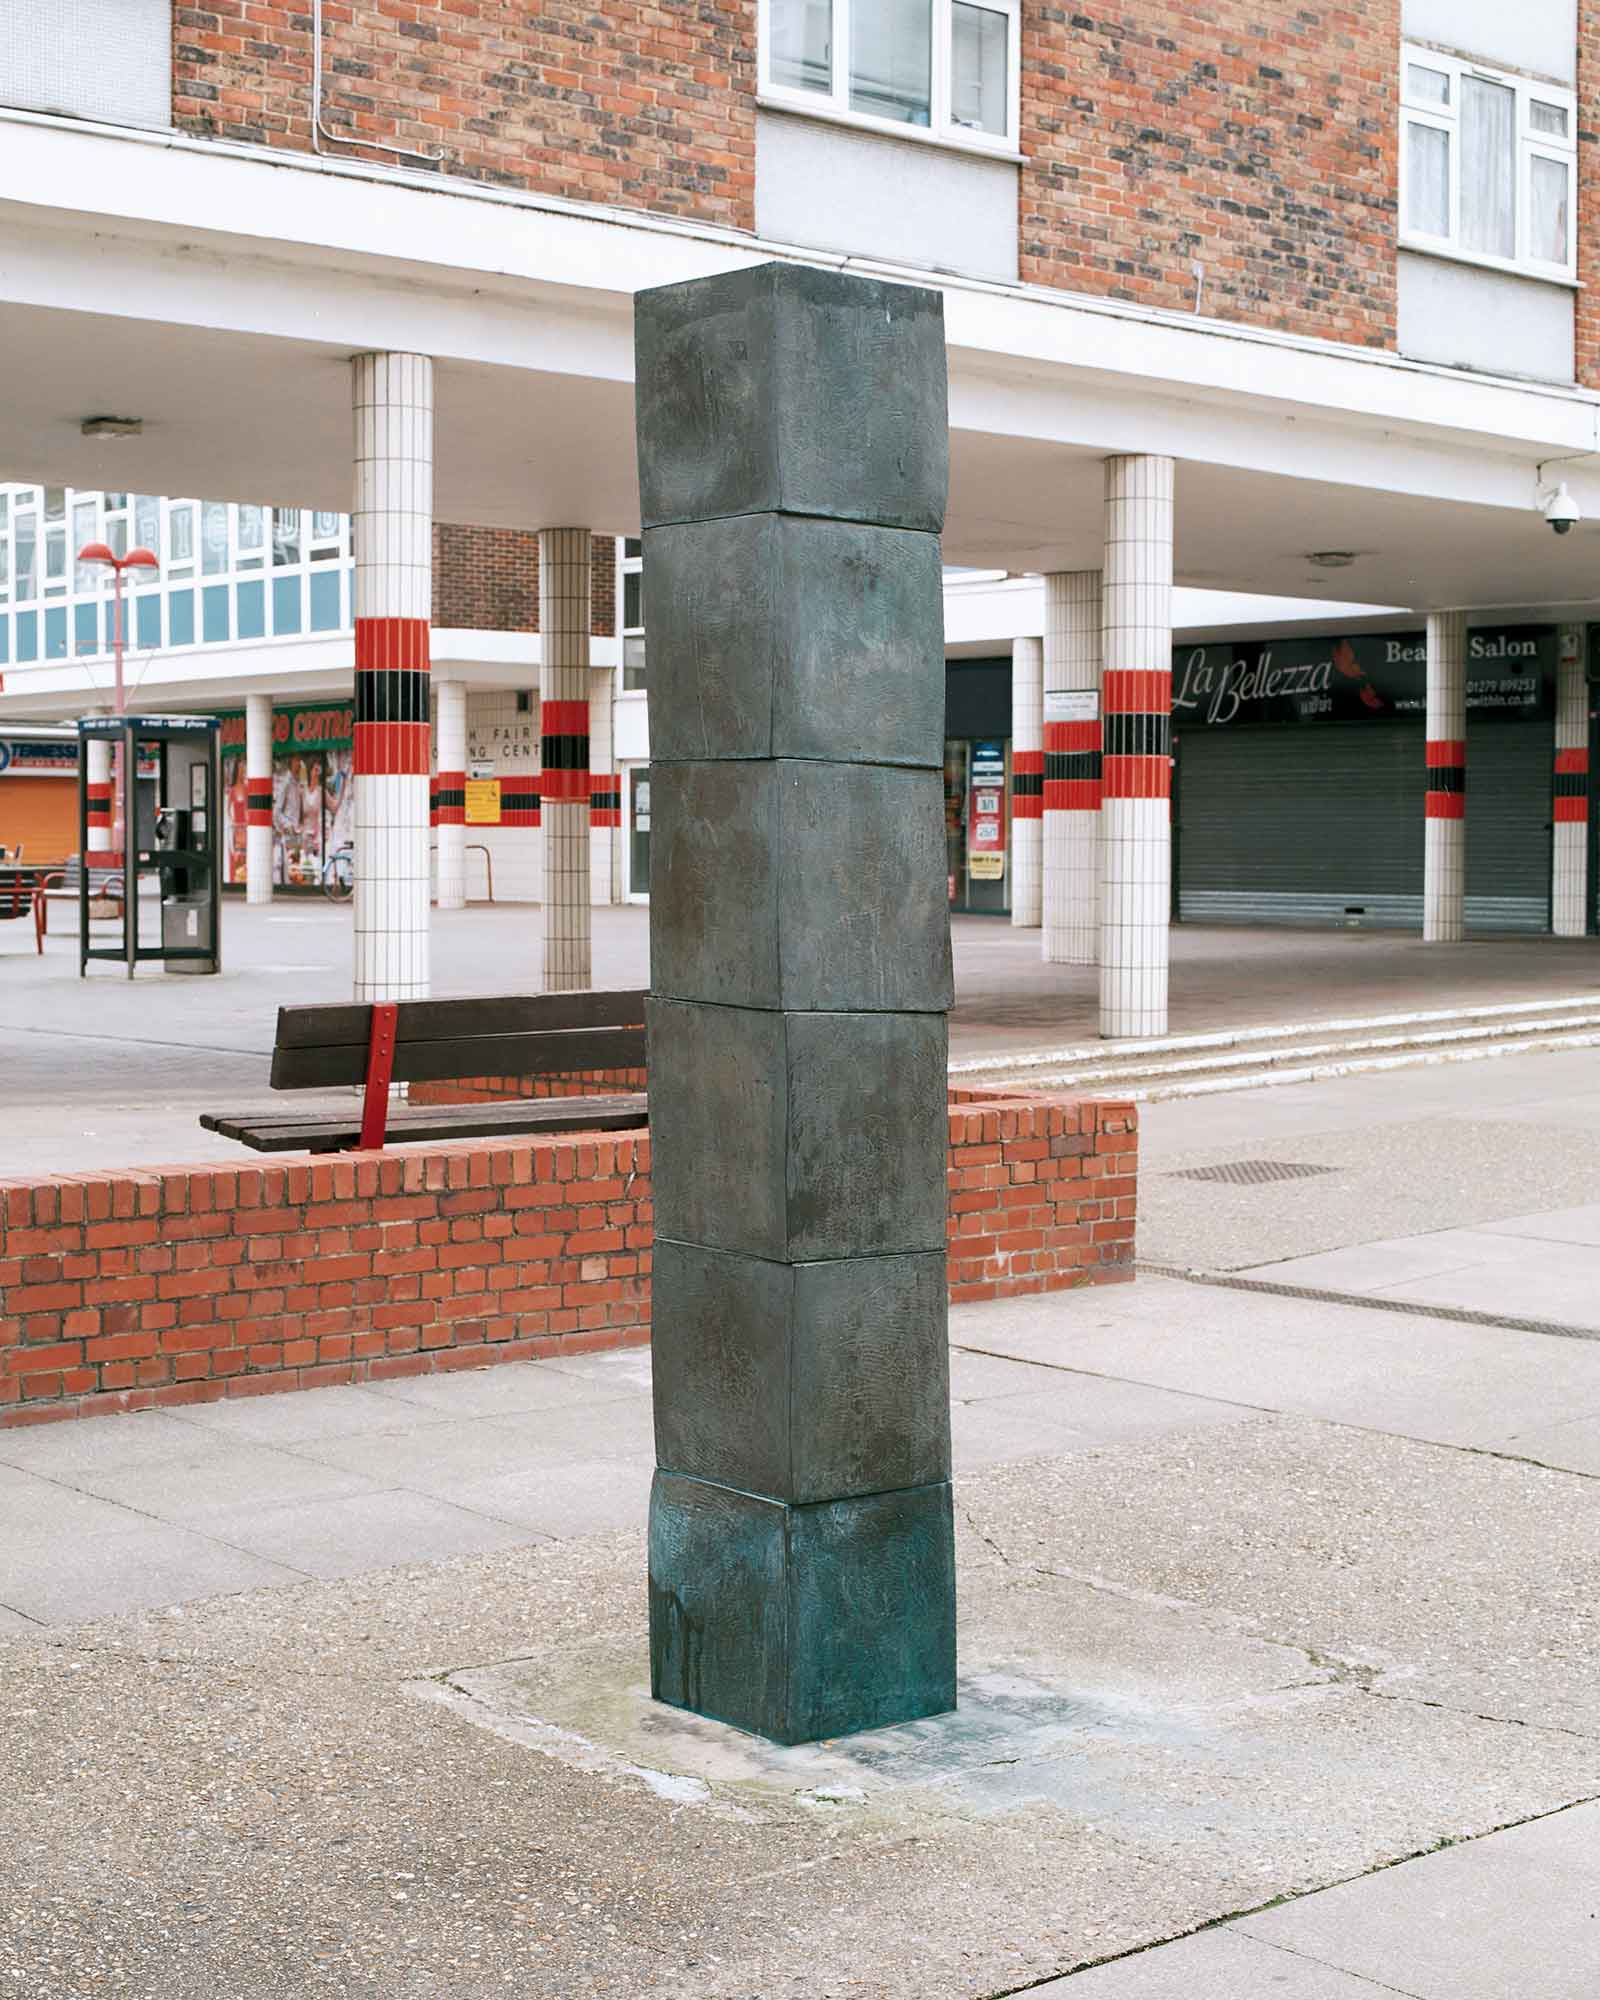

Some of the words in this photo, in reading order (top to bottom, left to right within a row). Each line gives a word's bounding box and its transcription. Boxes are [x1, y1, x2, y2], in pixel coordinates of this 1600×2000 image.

[1386, 640, 1427, 663] Bea
[1470, 636, 1537, 658] Salon
[1172, 647, 1214, 708] La
[1207, 651, 1332, 724] Bellezza
[494, 727, 530, 740] FAIR
[503, 744, 540, 758] CENT
